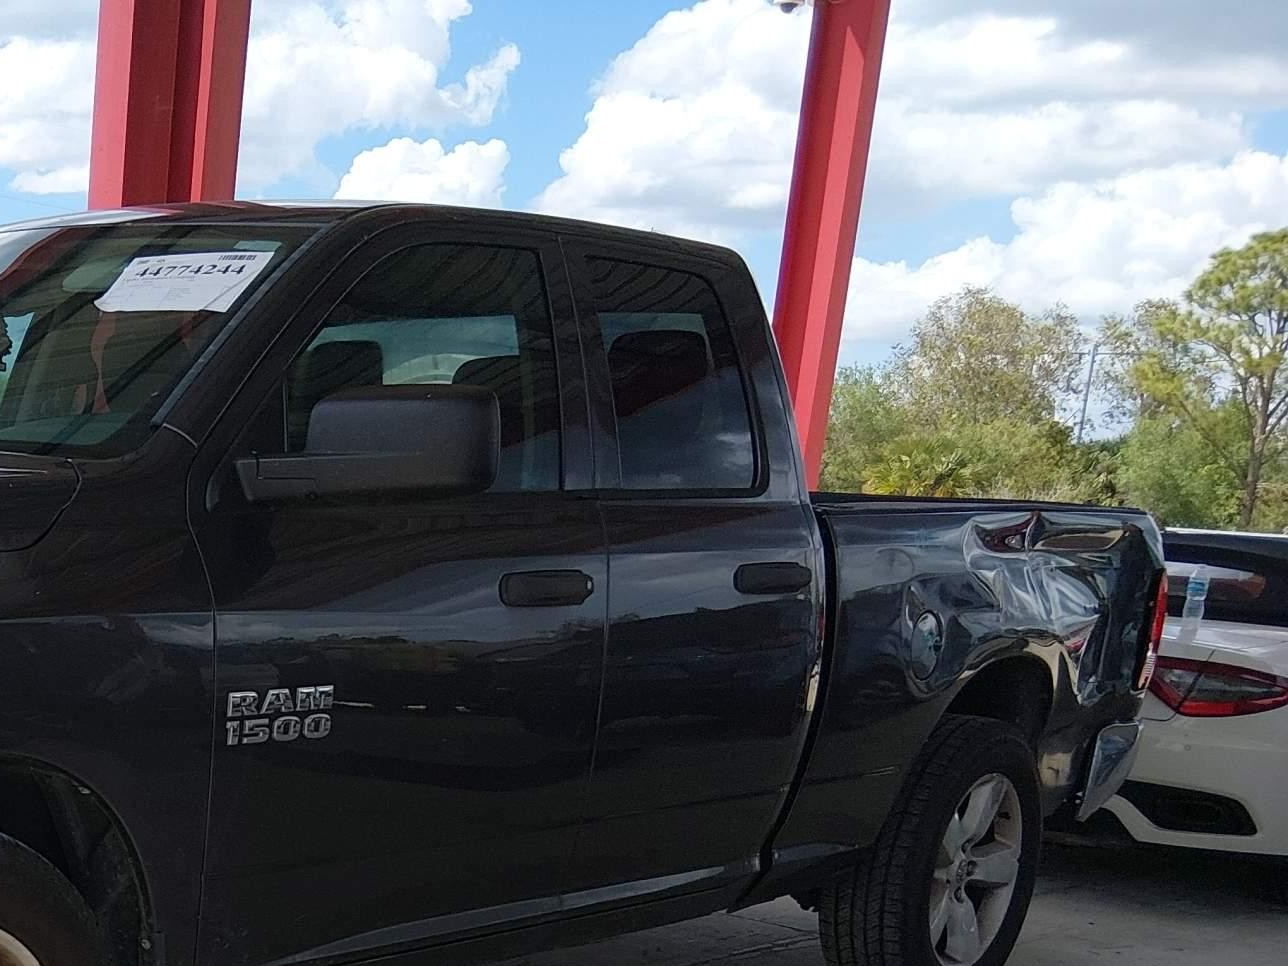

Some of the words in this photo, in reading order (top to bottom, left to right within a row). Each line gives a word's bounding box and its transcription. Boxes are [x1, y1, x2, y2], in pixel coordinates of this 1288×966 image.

[136, 254, 247, 278] 44774244
[226, 685, 335, 718] RAM
[226, 713, 332, 746] 1500
